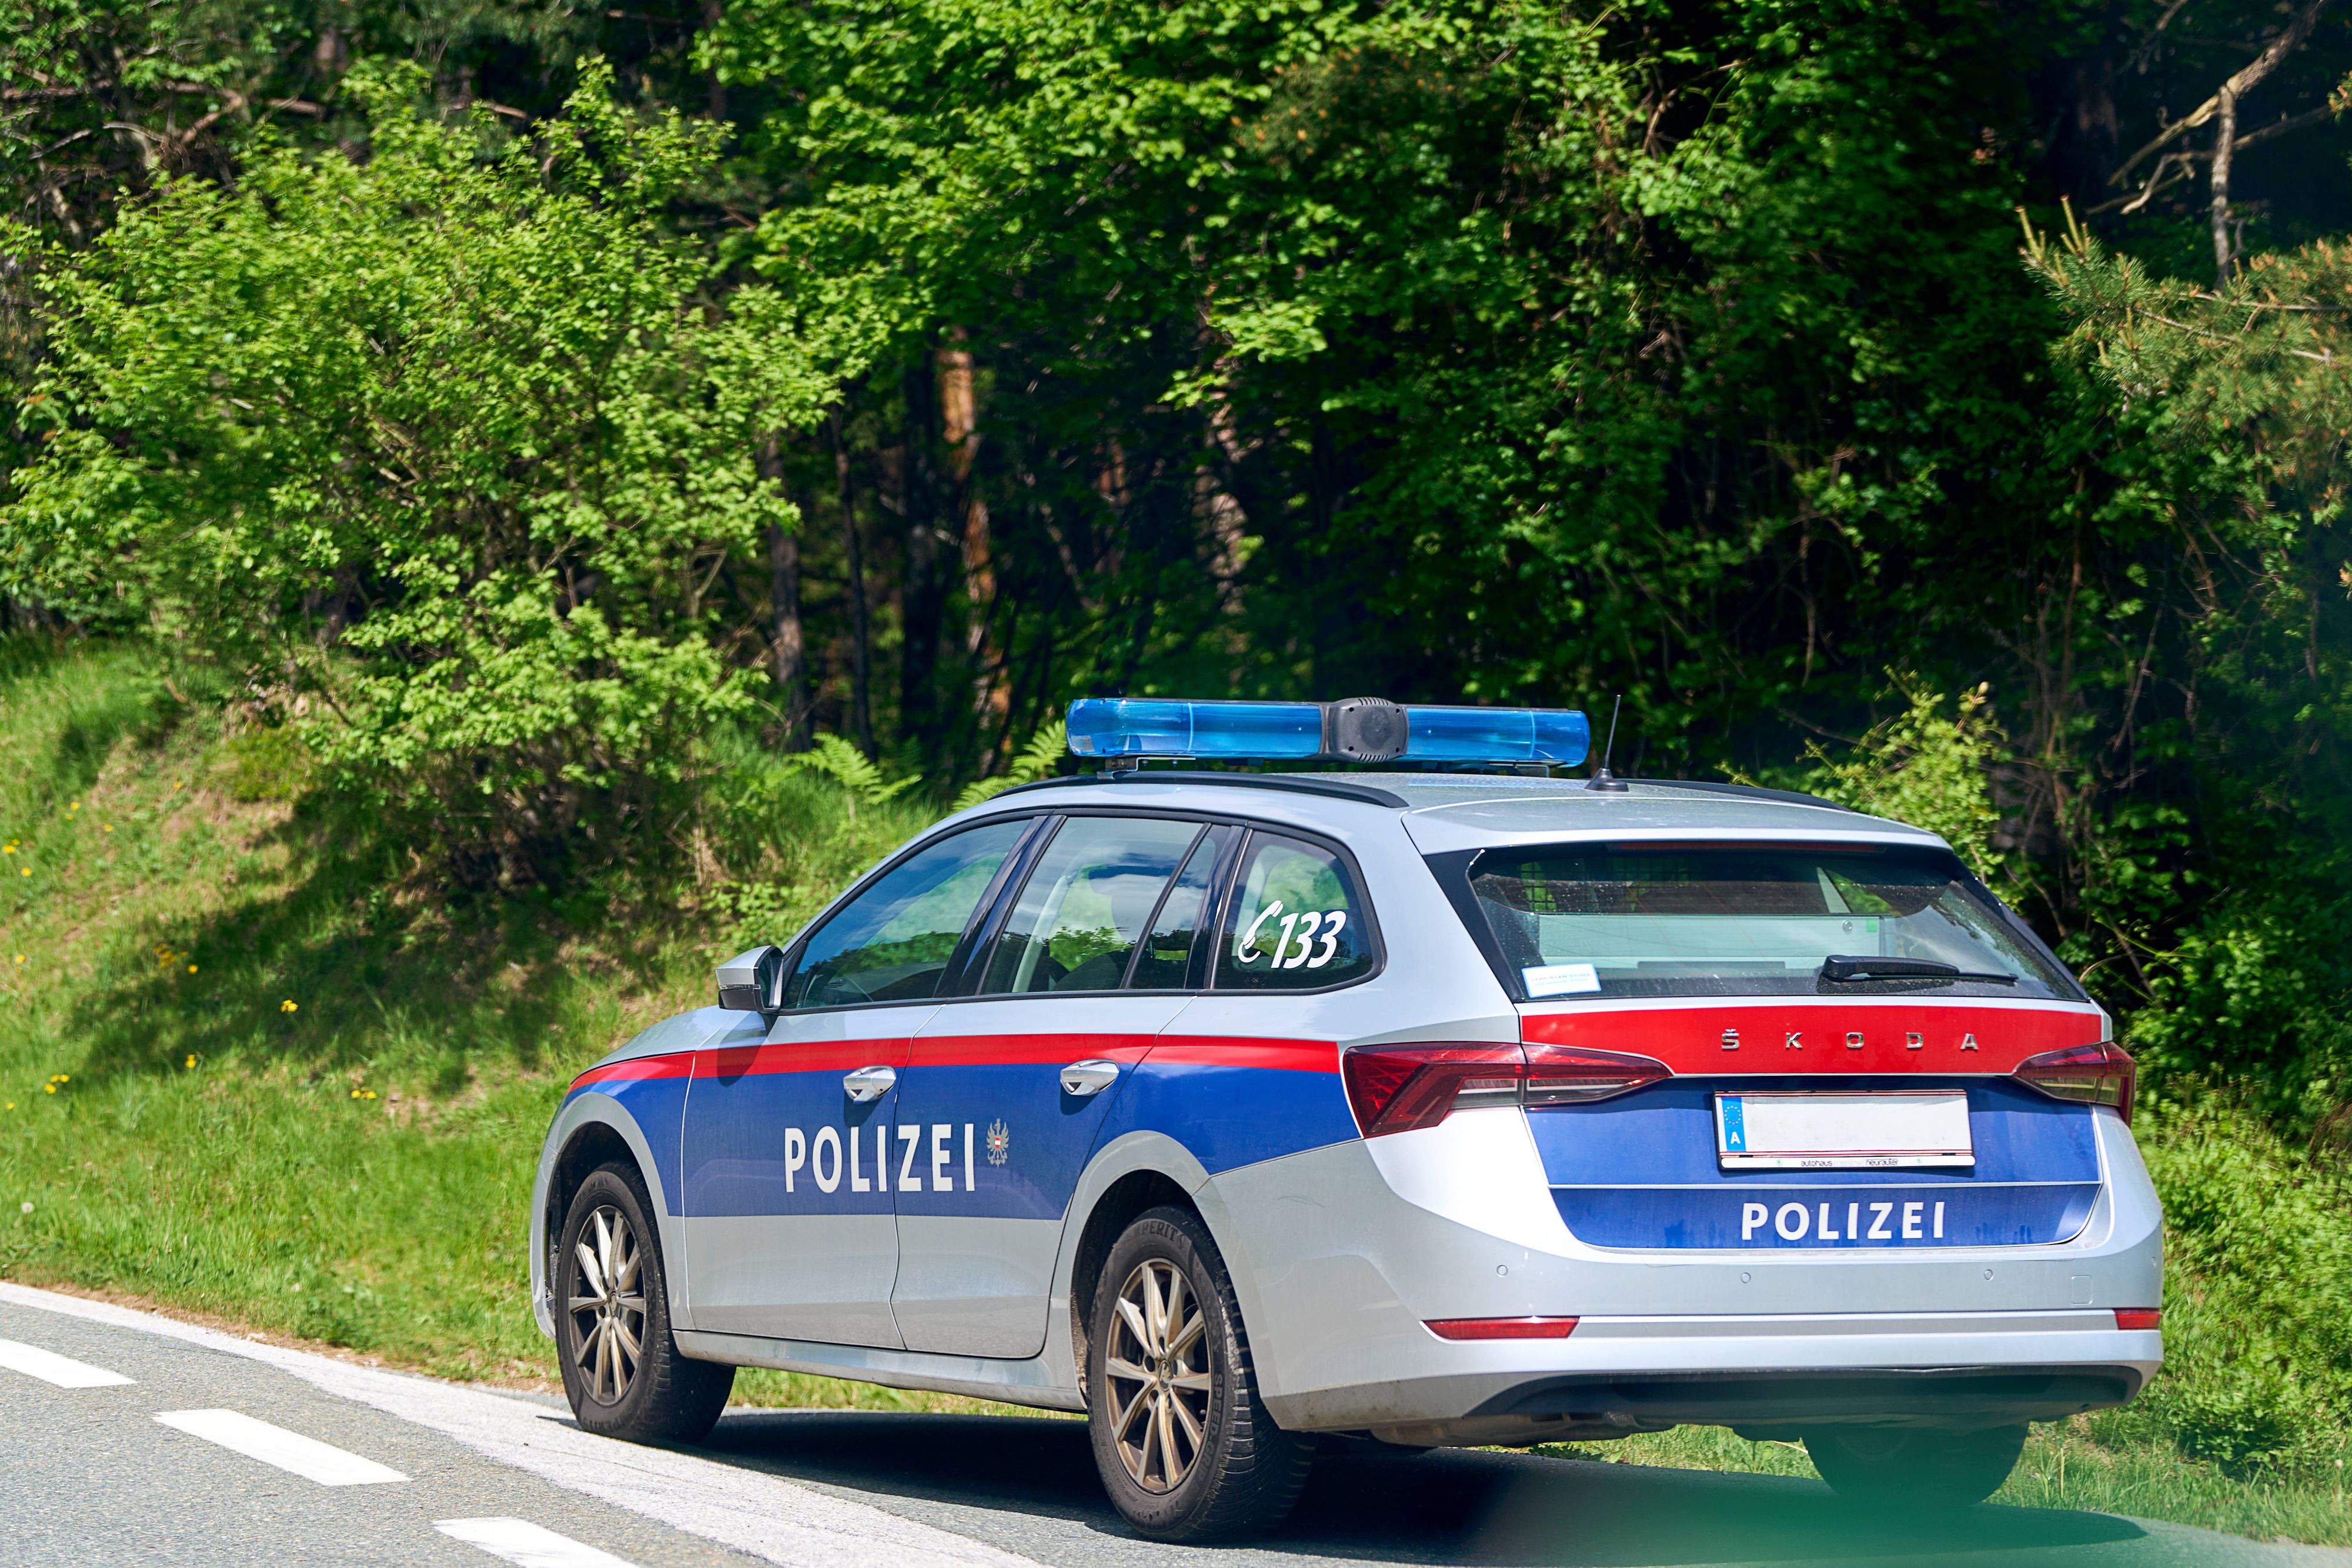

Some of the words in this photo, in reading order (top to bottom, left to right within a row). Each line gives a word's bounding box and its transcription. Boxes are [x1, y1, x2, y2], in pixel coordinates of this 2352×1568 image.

[1271, 911, 1347, 969] 133
[1721, 1029, 1979, 1051] ŠKODA
[1730, 1132, 1741, 1144] A
[784, 1123, 975, 1193] POLIZEI
[1742, 1202, 1945, 1241] POLIZEI
